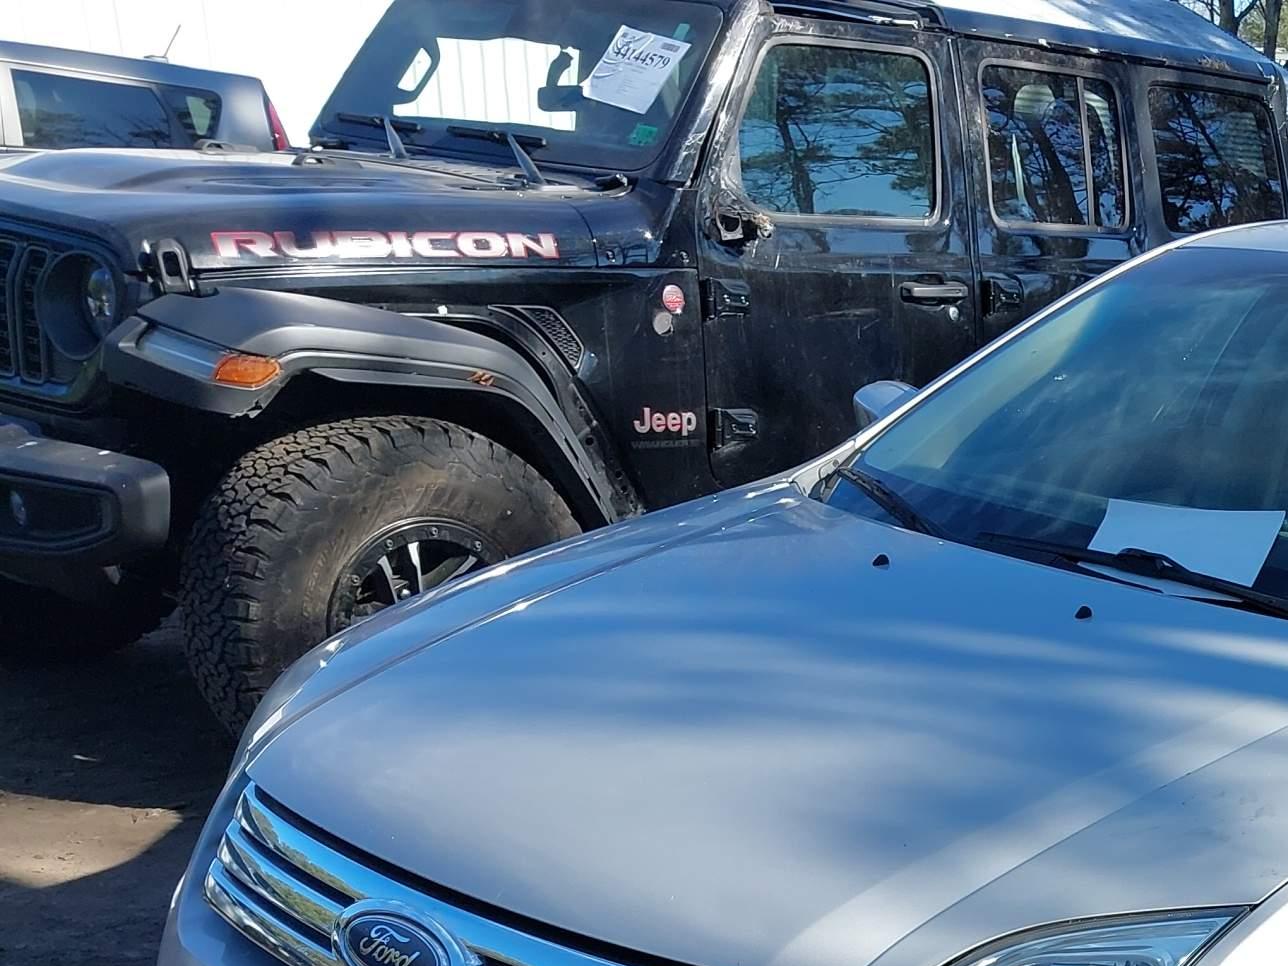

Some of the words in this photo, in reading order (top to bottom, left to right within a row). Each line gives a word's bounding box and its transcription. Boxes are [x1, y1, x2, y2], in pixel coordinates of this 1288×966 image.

[613, 45, 671, 69] 44144579
[210, 231, 561, 259] RUBICON
[633, 407, 697, 436] Jeep
